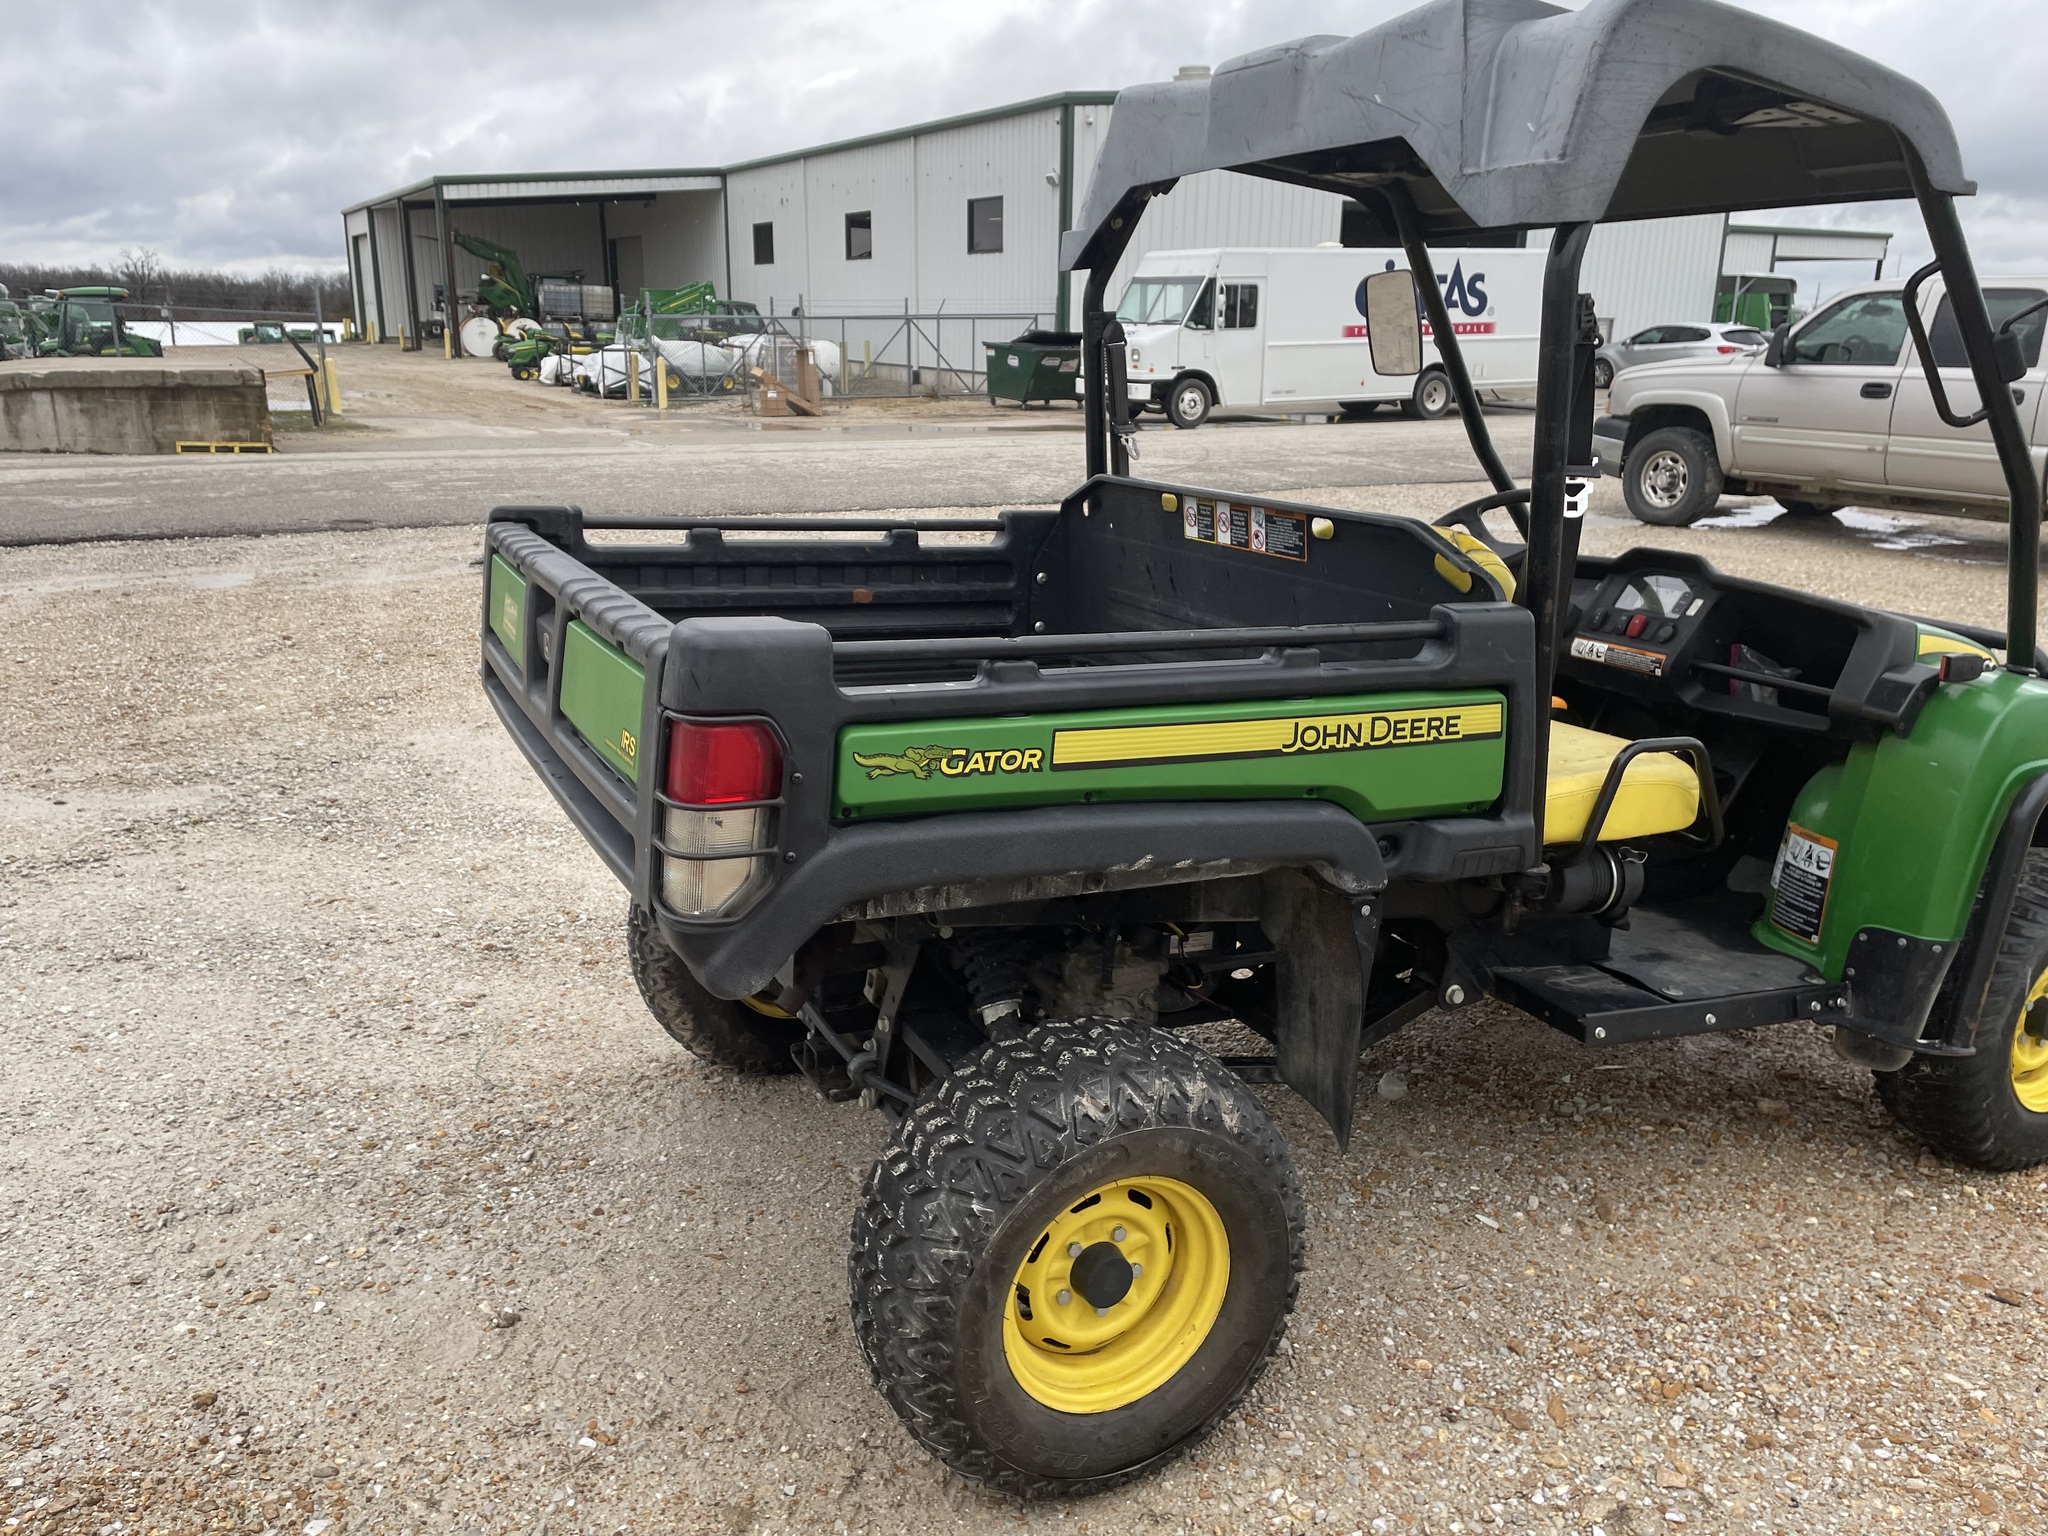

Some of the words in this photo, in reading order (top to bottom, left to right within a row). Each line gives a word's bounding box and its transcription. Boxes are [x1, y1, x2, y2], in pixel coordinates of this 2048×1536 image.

[621, 728, 637, 757] IRS
[1282, 721, 1363, 751] JOHN
[1370, 715, 1463, 743] DEERE
[940, 748, 1044, 776] GATOR
